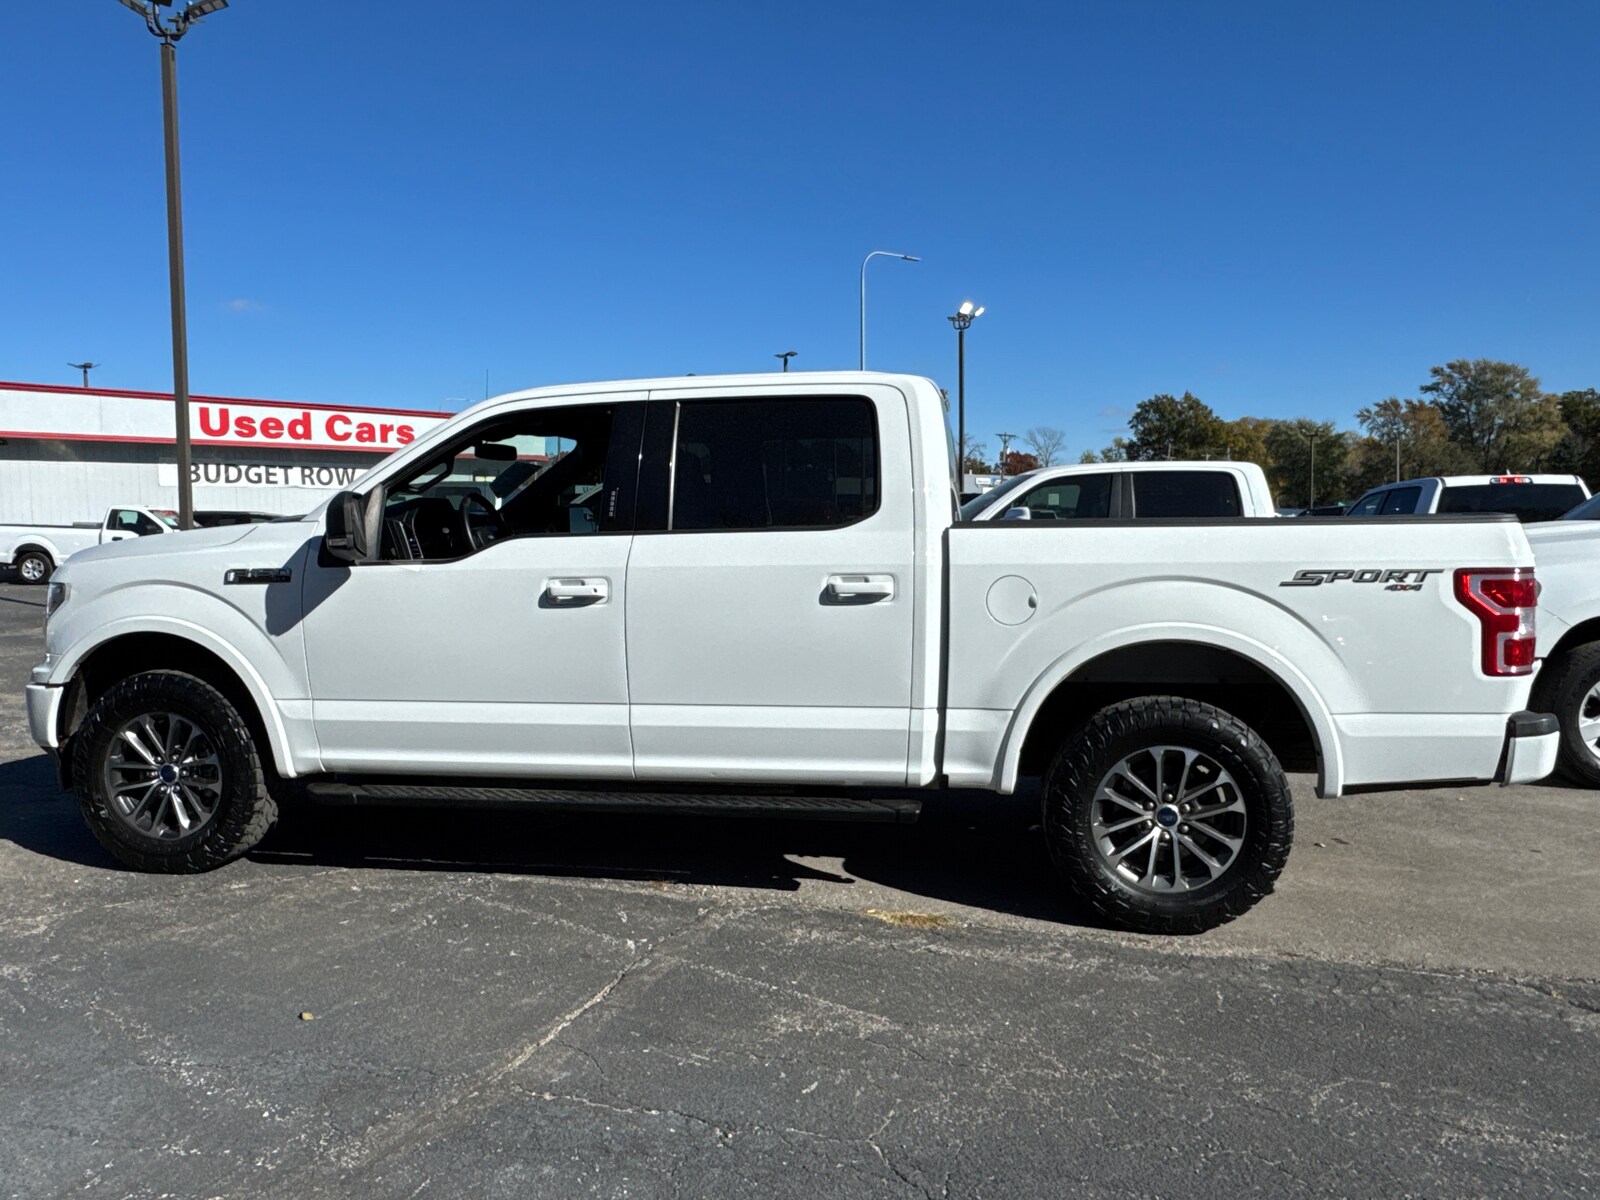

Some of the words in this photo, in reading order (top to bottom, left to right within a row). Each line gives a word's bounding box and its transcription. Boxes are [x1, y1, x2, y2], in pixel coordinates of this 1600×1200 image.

[199, 407, 312, 441] Used
[325, 414, 415, 445] Cars
[190, 463, 293, 486] BUDGET
[301, 466, 355, 487] ROW
[1278, 569, 1444, 587] SPORT
